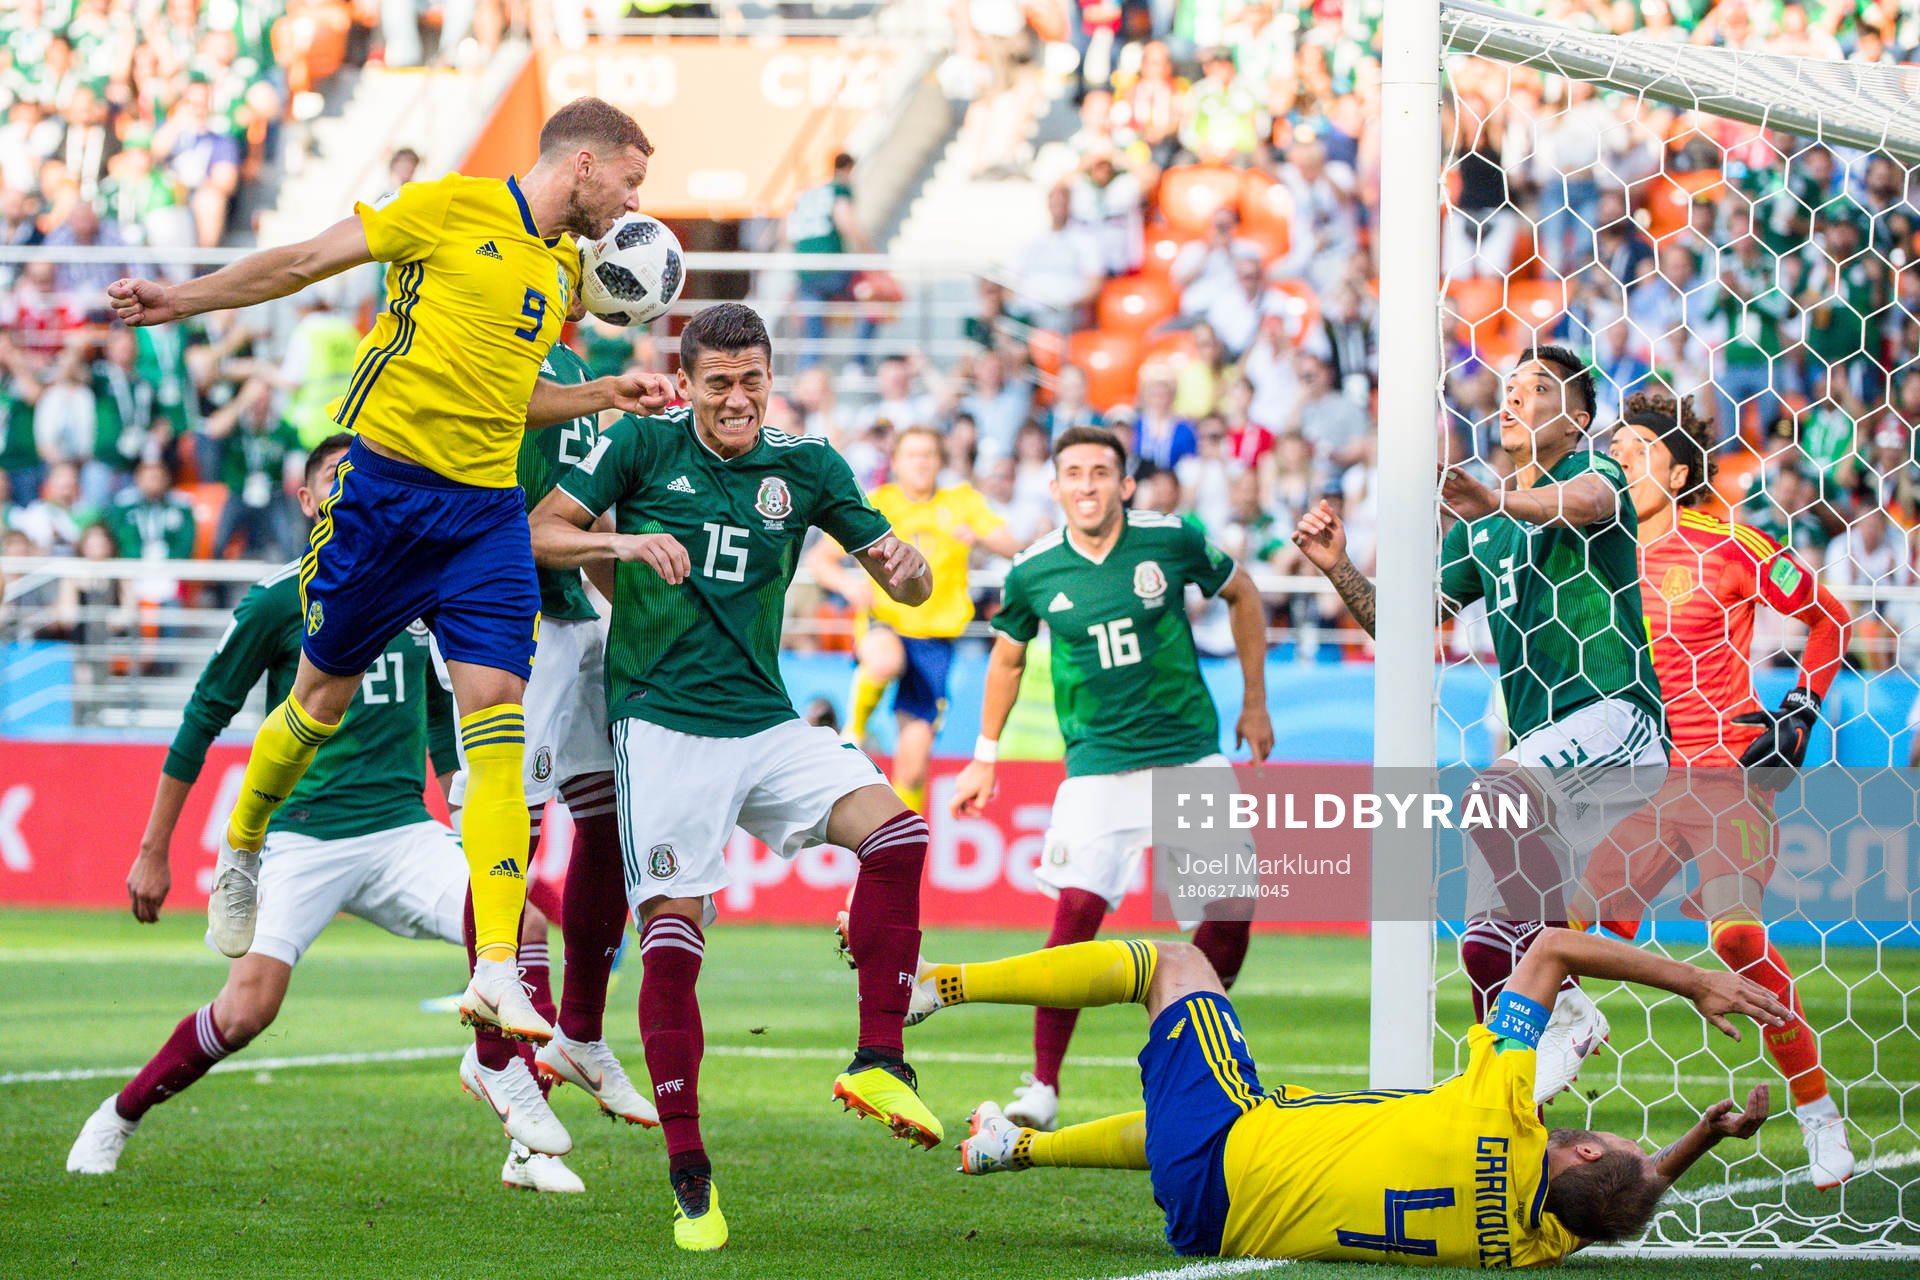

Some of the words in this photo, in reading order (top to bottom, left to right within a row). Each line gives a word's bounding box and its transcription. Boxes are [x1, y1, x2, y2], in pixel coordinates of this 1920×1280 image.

[475, 248, 503, 261] adidas
[514, 287, 547, 342] 9
[666, 482, 697, 495] adidas
[702, 521, 750, 582] 15
[1498, 553, 1519, 609] 3
[1087, 617, 1142, 669] 16
[362, 651, 405, 704] 21
[1730, 818, 1767, 873] 13
[489, 869, 524, 880] adidas
[1509, 1000, 1531, 1015] FIFA
[656, 1079, 684, 1097] FMF
[1336, 1187, 1456, 1257] 4
